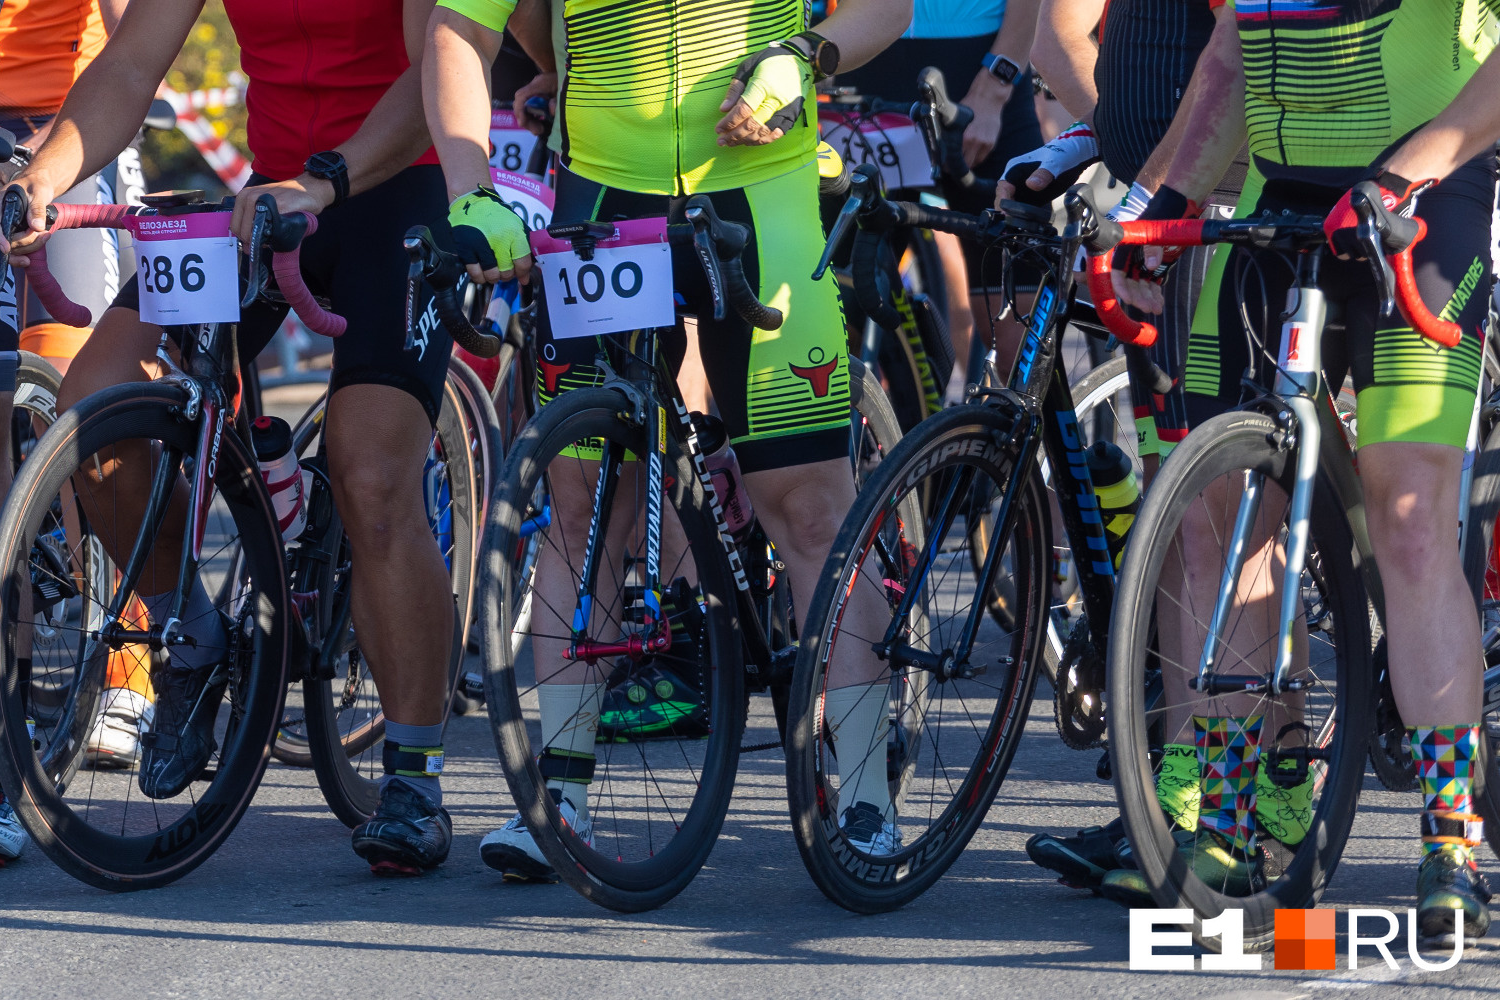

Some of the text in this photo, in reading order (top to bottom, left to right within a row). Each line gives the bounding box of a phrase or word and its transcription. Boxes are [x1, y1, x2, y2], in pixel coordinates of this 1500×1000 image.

[496, 171, 541, 191] ВЕЛОЗАЕЗД
[139, 219, 187, 230] ВЕЛОЗАЕЗД
[141, 253, 206, 294] 286
[558, 260, 644, 306] 100
[699, 250, 720, 303] ULTEGRA
[1018, 285, 1056, 385] GIANT
[208, 407, 226, 479] ORBEA
[1244, 418, 1272, 428] PIRELLI
[647, 452, 663, 583] SPECIALIZED
